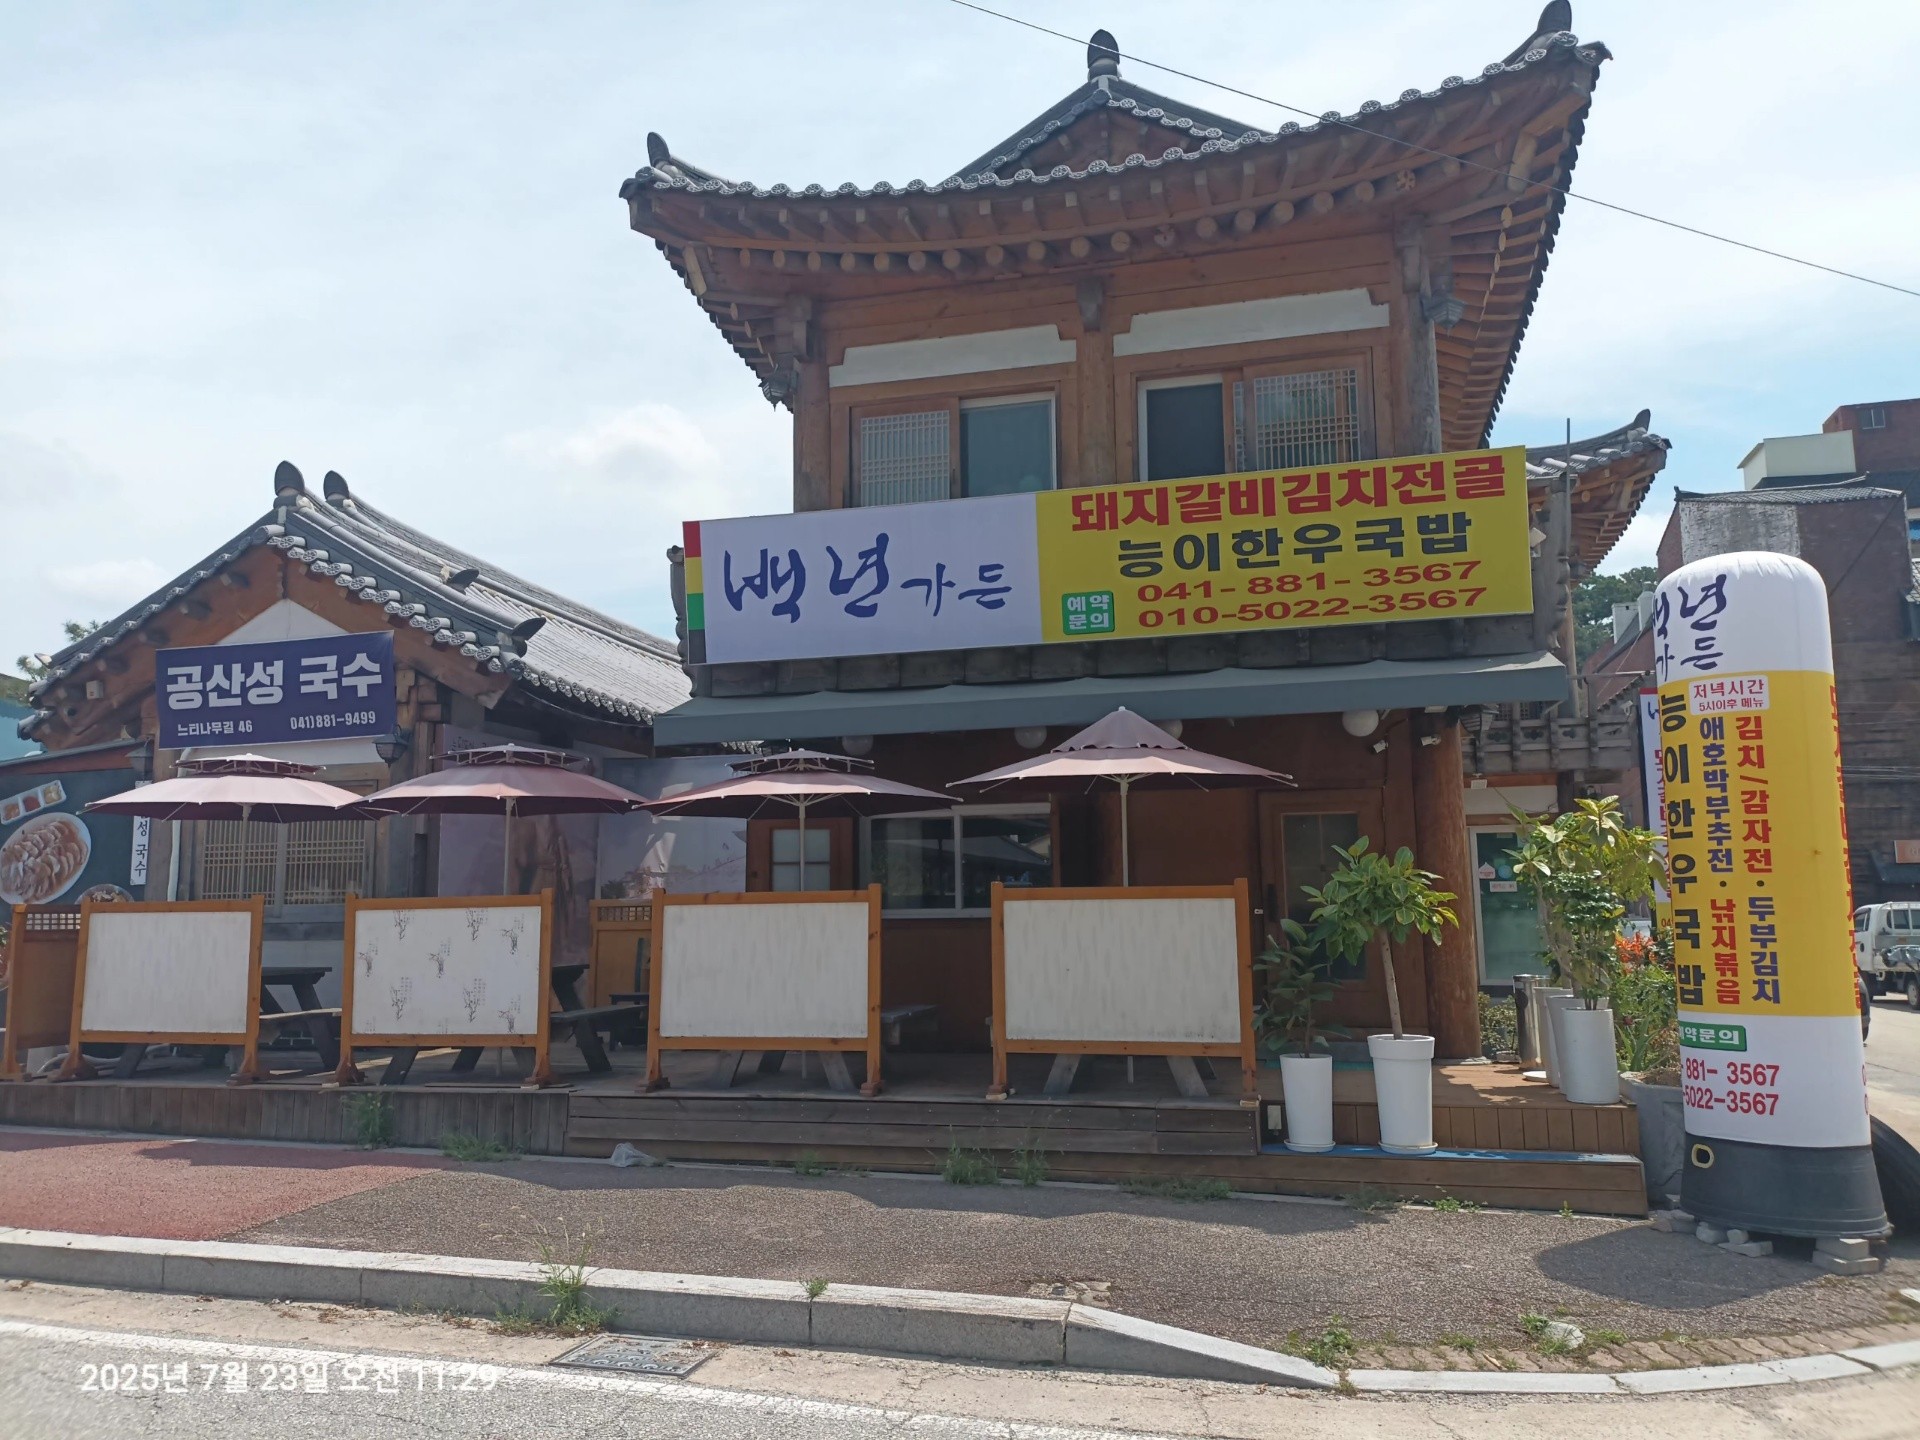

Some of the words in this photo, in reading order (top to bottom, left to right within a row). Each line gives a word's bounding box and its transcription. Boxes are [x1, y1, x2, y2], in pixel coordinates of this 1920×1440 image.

[1071, 455, 1506, 533] 돼지갈비김치전골
[1118, 512, 1472, 579] 능이한우국밥
[1138, 587, 1488, 629] 010-5022-3567
[166, 660, 284, 710] 공산성
[300, 653, 382, 700] 국수
[1693, 679, 1765, 699] 저녁시간
[290, 711, 376, 730] 041)881-9499
[1699, 698, 1738, 711] 5시이후
[1741, 698, 1764, 708] 메뉴
[177, 721, 235, 736] 느티나무길
[238, 719, 253, 733] 46
[1661, 694, 1706, 1006] 능이한우국밥
